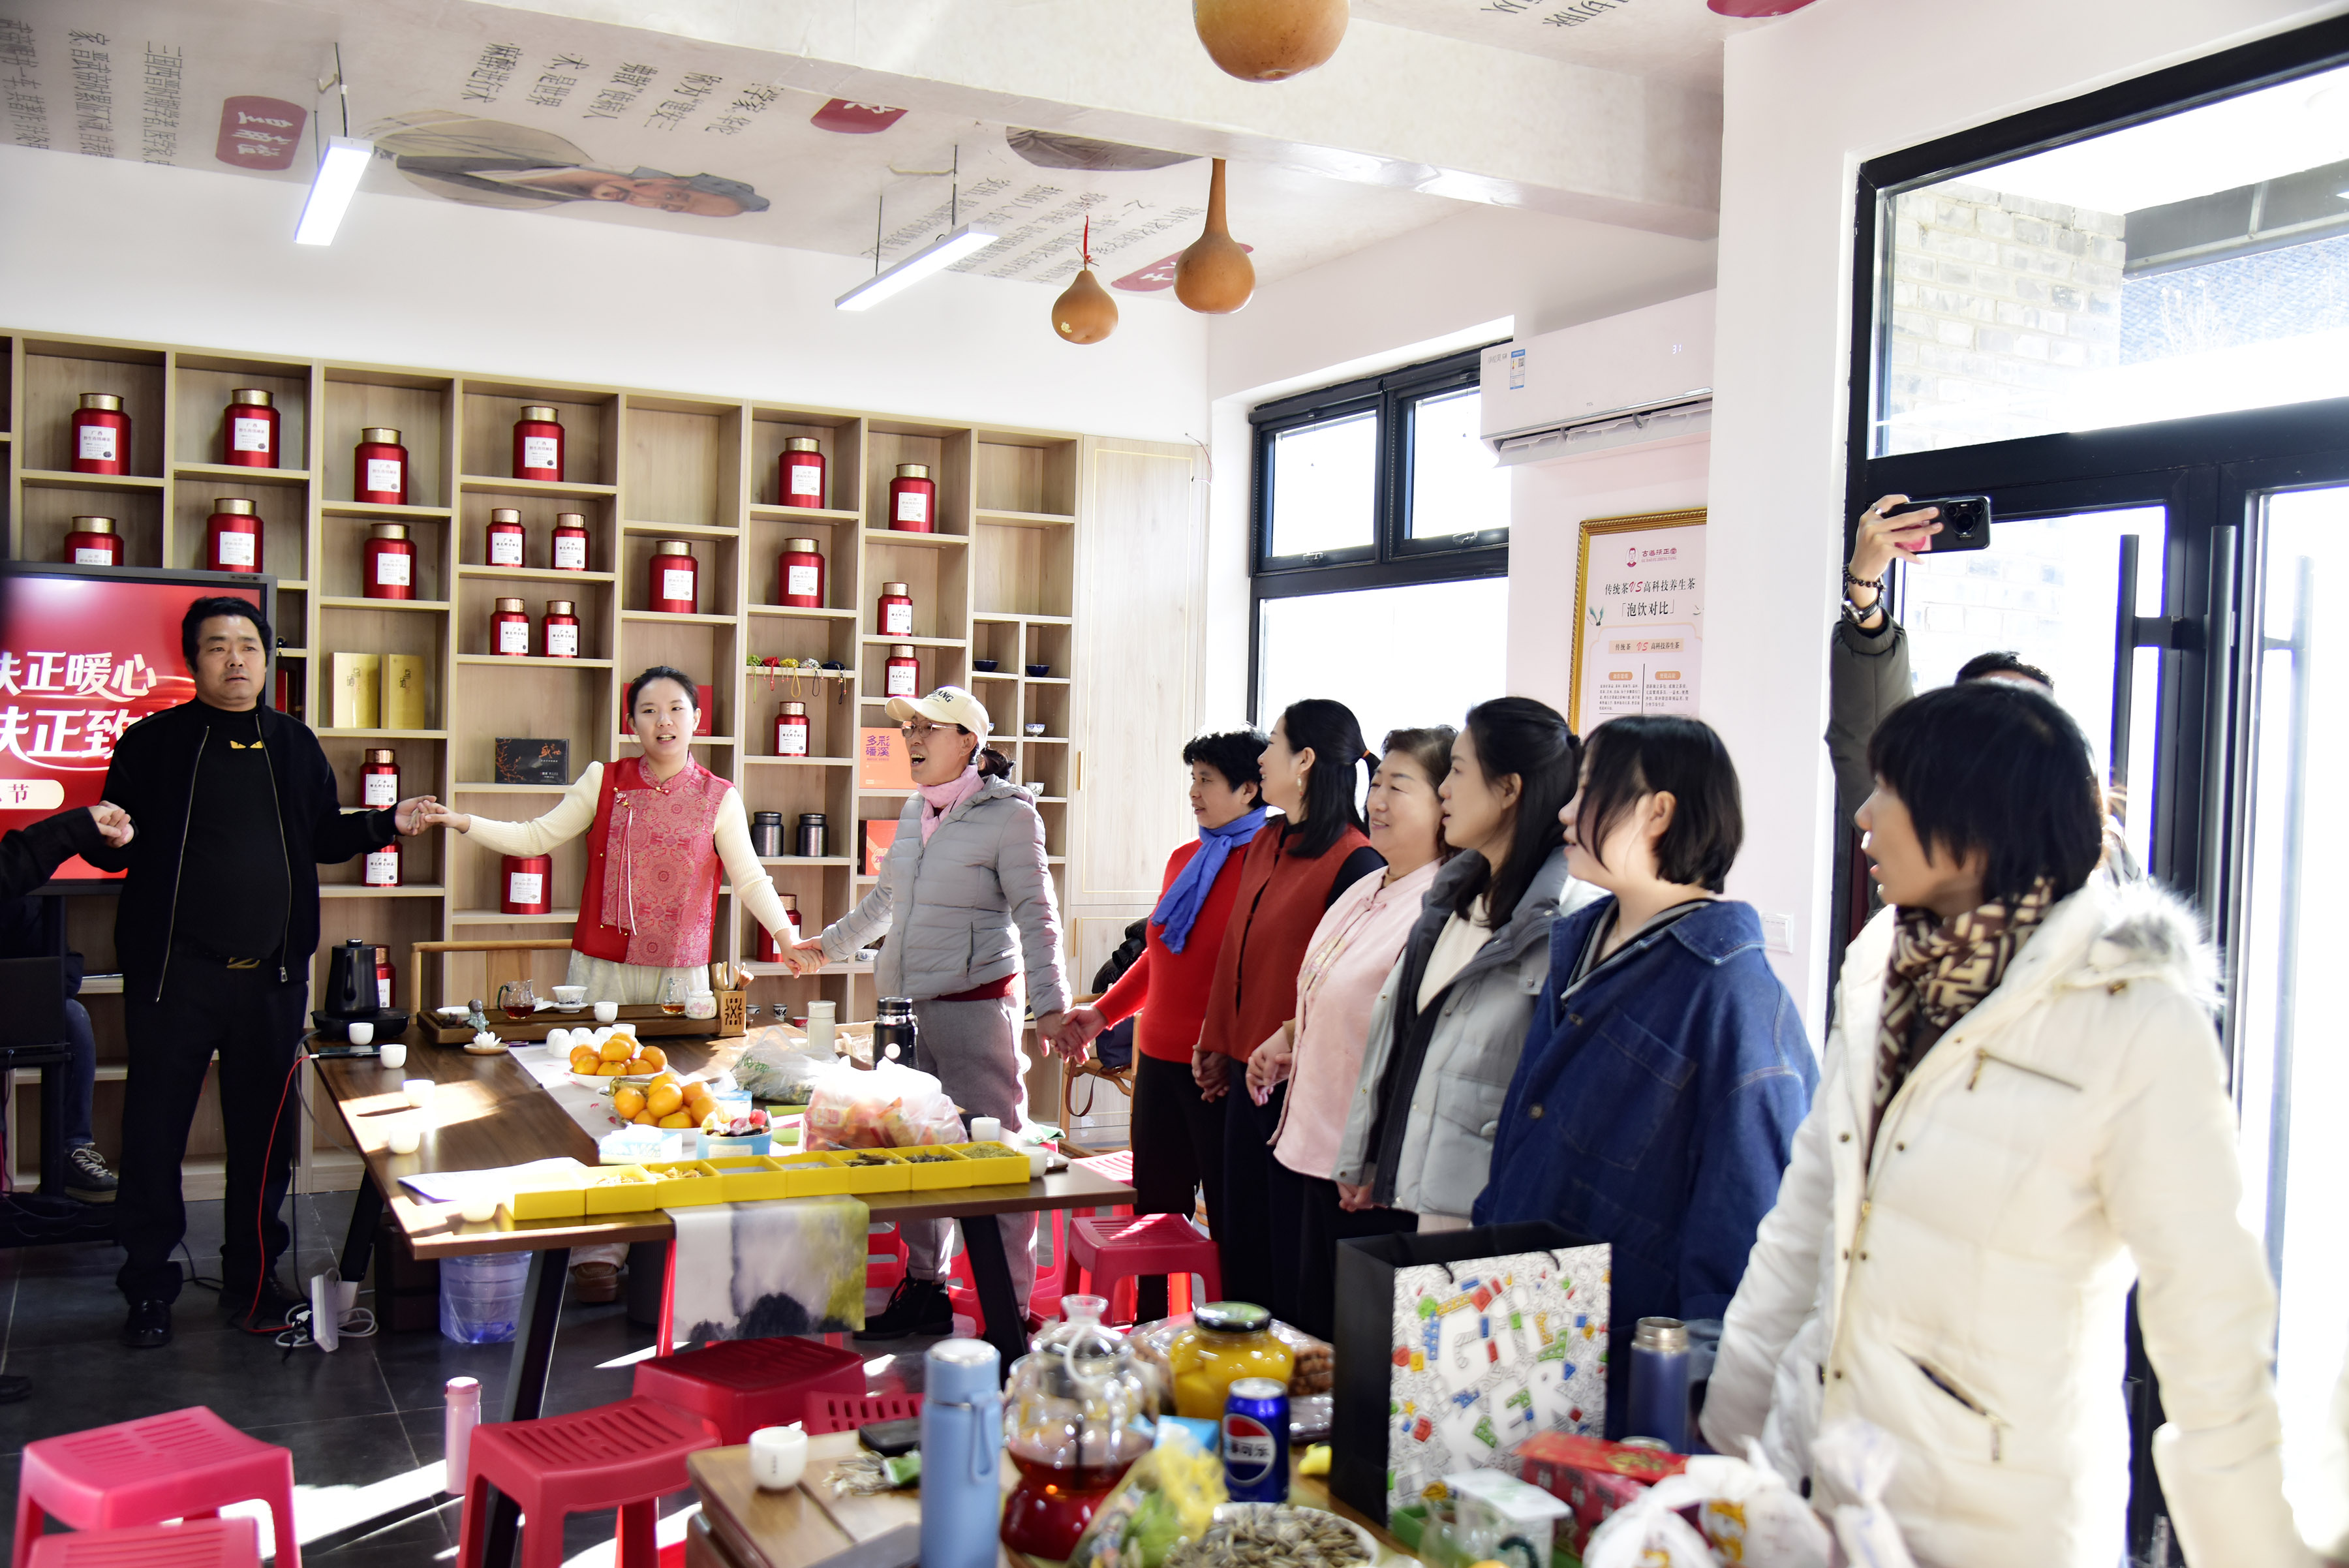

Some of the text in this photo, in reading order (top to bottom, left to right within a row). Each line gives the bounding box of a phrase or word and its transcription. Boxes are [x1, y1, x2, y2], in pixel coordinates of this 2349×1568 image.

[1543, 0, 1631, 27] 切脉
[459, 41, 525, 105] 麻醉进行术
[525, 52, 591, 109] 术，是世界
[705, 82, 785, 136] 学家。华佗
[1672, 345, 1682, 354] 31
[1636, 641, 1648, 651] VS
[1651, 641, 1680, 650] 高科技养生茶
[0, 706, 149, 769] 正致
[866, 735, 890, 746] 多彩
